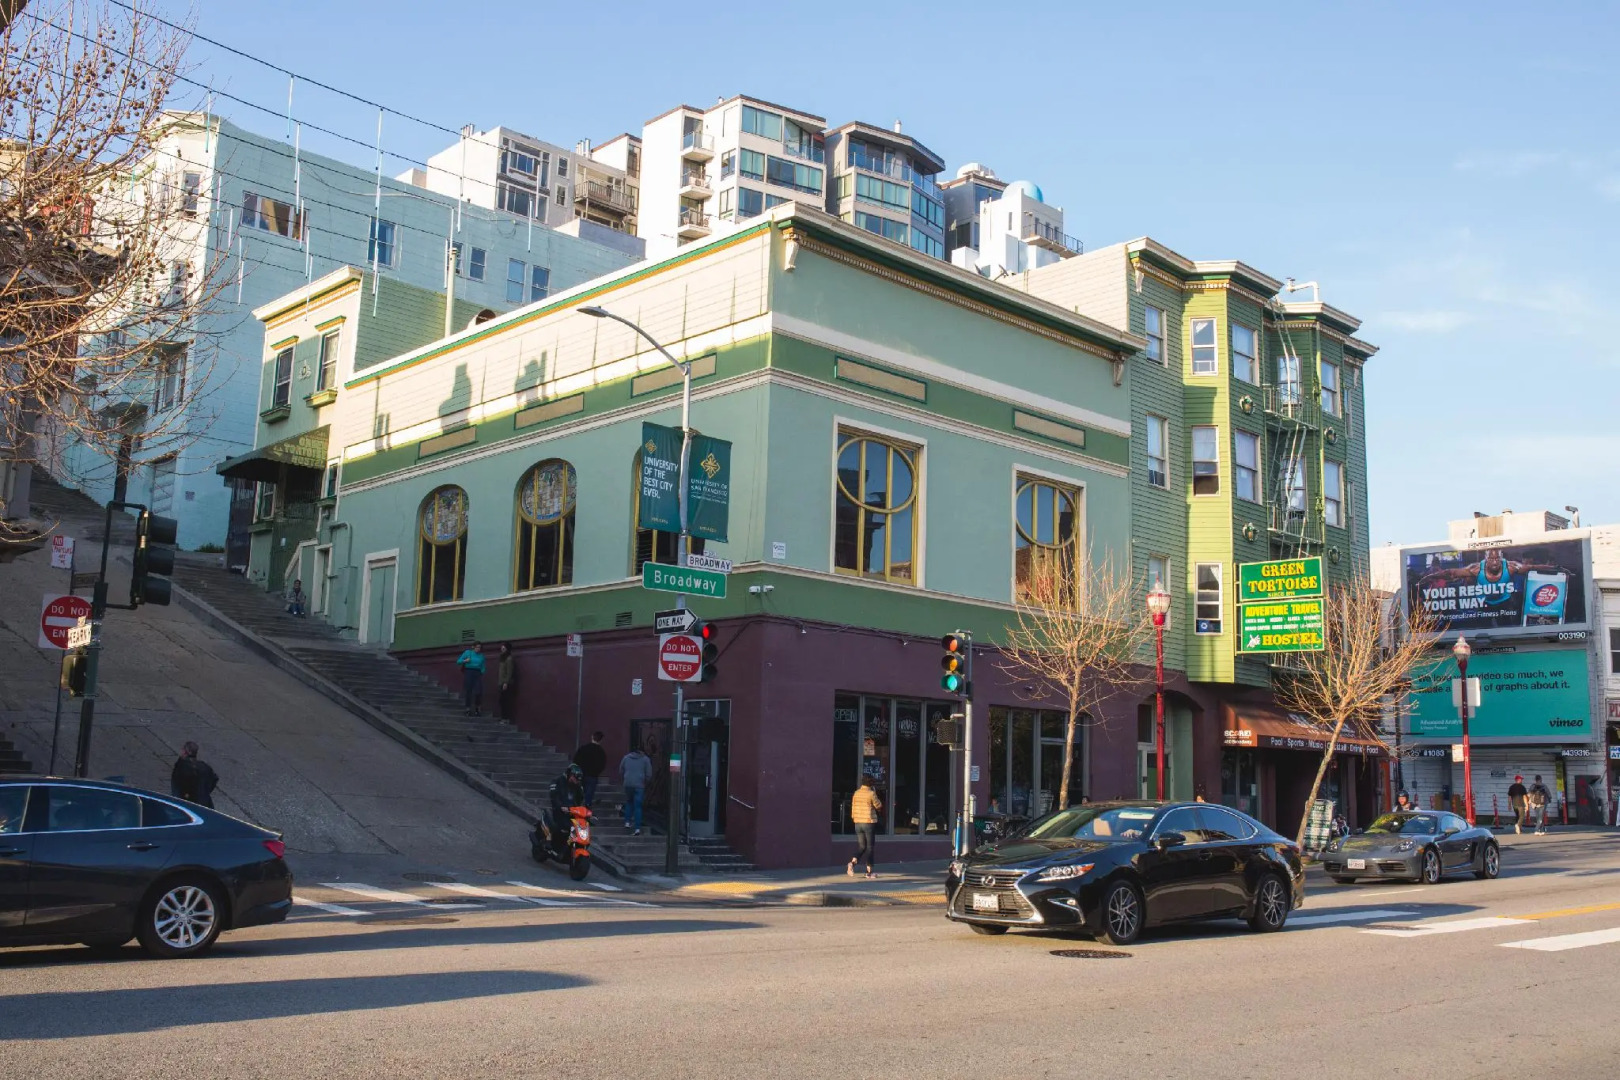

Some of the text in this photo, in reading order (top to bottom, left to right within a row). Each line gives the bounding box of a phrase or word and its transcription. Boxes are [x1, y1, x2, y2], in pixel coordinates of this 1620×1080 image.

[644, 456, 679, 472] UNIVERSITY
[644, 467, 666, 480] OF THE
[643, 477, 673, 492] BEST CITY
[643, 488, 661, 499] EVER.
[689, 556, 731, 570] BROADWAY
[1261, 562, 1305, 577] GREEN
[654, 570, 717, 594] Broadway
[1248, 576, 1318, 593] TORTOISE
[1423, 582, 1518, 599] YOUR RESULTS.
[1245, 603, 1320, 617] ADVENTURE TRAVEL
[1424, 597, 1487, 611] YOUR WAY.
[51, 606, 91, 616] DO NOT
[658, 616, 684, 627] ONE WAY
[1262, 633, 1321, 646] HOSTEL
[1558, 632, 1586, 640] 003190
[666, 643, 697, 653] DO NOT
[668, 664, 692, 672] ENTER
[1517, 670, 1548, 679] much,
[1549, 670, 1564, 678] we
[1484, 683, 1494, 692] of
[1495, 682, 1529, 693] graphs
[1530, 681, 1559, 690] about
[1561, 680, 1571, 689] it.
[1549, 717, 1584, 728] vimeo
[1270, 737, 1283, 746] Pool
[1287, 738, 1305, 748] Sports
[1366, 745, 1379, 755] Food
